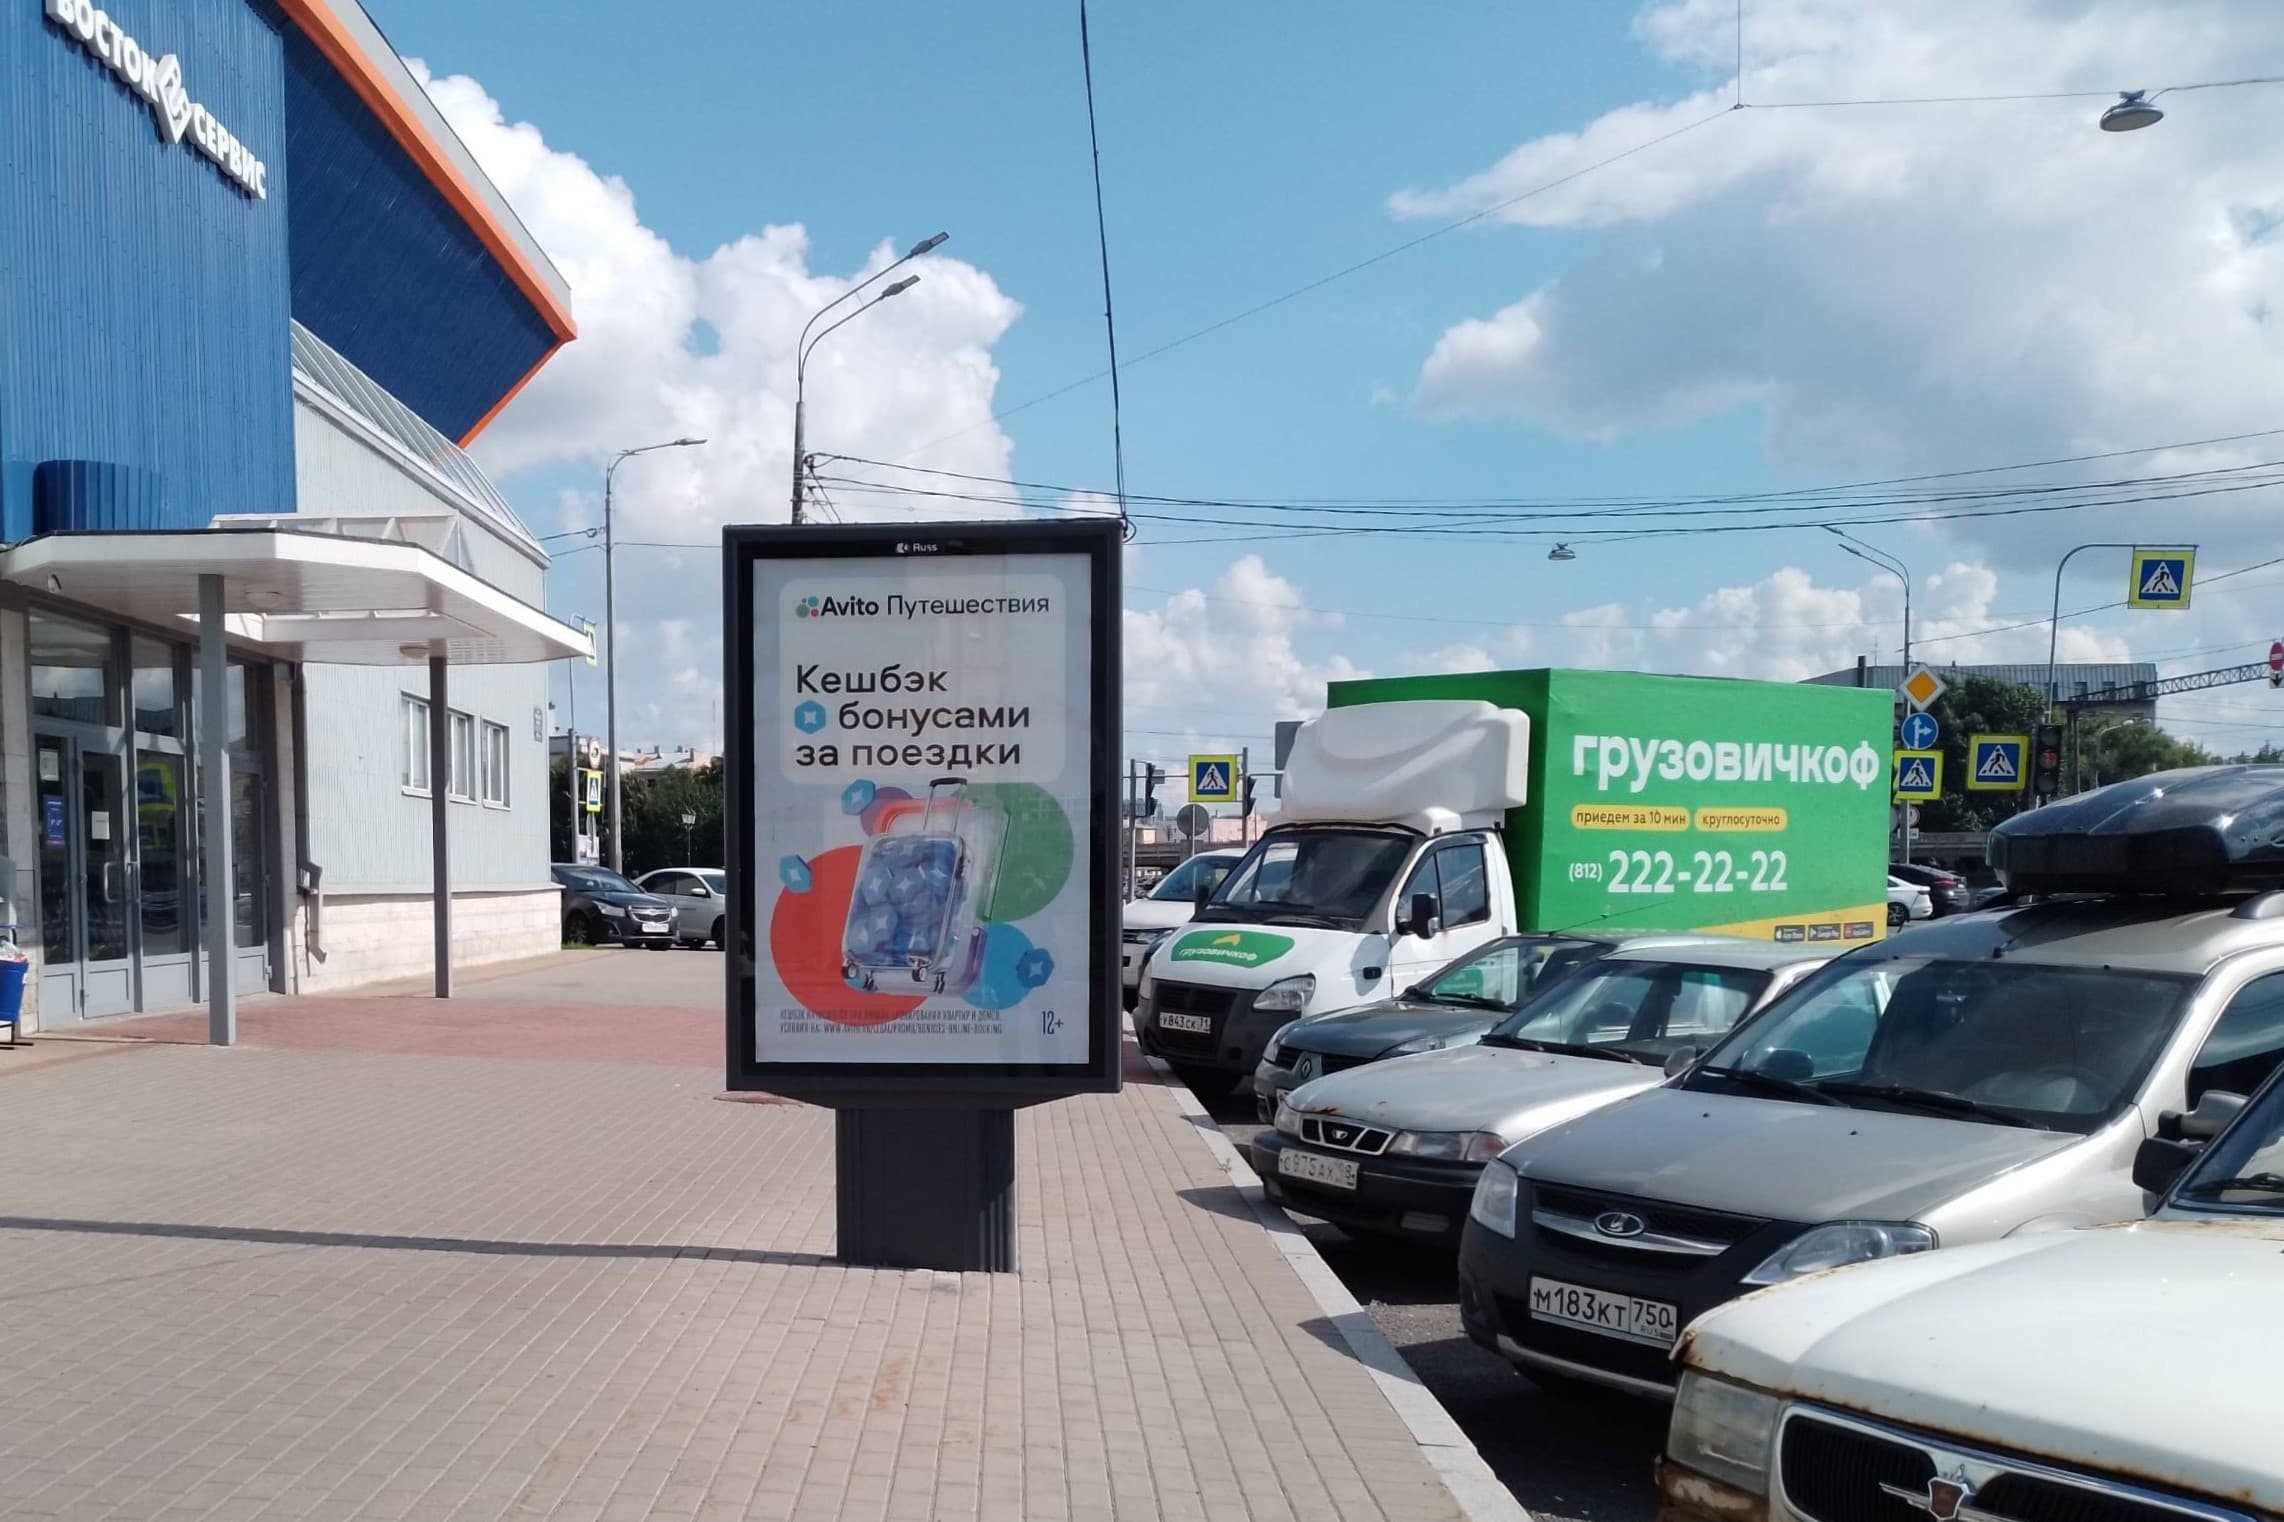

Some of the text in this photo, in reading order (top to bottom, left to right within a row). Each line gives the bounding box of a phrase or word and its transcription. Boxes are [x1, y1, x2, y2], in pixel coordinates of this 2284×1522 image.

[188, 103, 267, 200] СЕРВИС
[820, 595, 1049, 620] Avito Путешествия
[796, 663, 948, 694] Кешбэк
[838, 701, 1030, 737] бонусами
[796, 743, 1020, 770] за поездки
[1573, 735, 1880, 793] грузовичкоф
[1576, 810, 1687, 826] приедем за 10 мин
[1702, 813, 1781, 828] круглосуточно
[1569, 850, 1788, 893] (812) 222-22-22
[1042, 1010, 1064, 1036] 12+
[1632, 1301, 1671, 1328] 750
